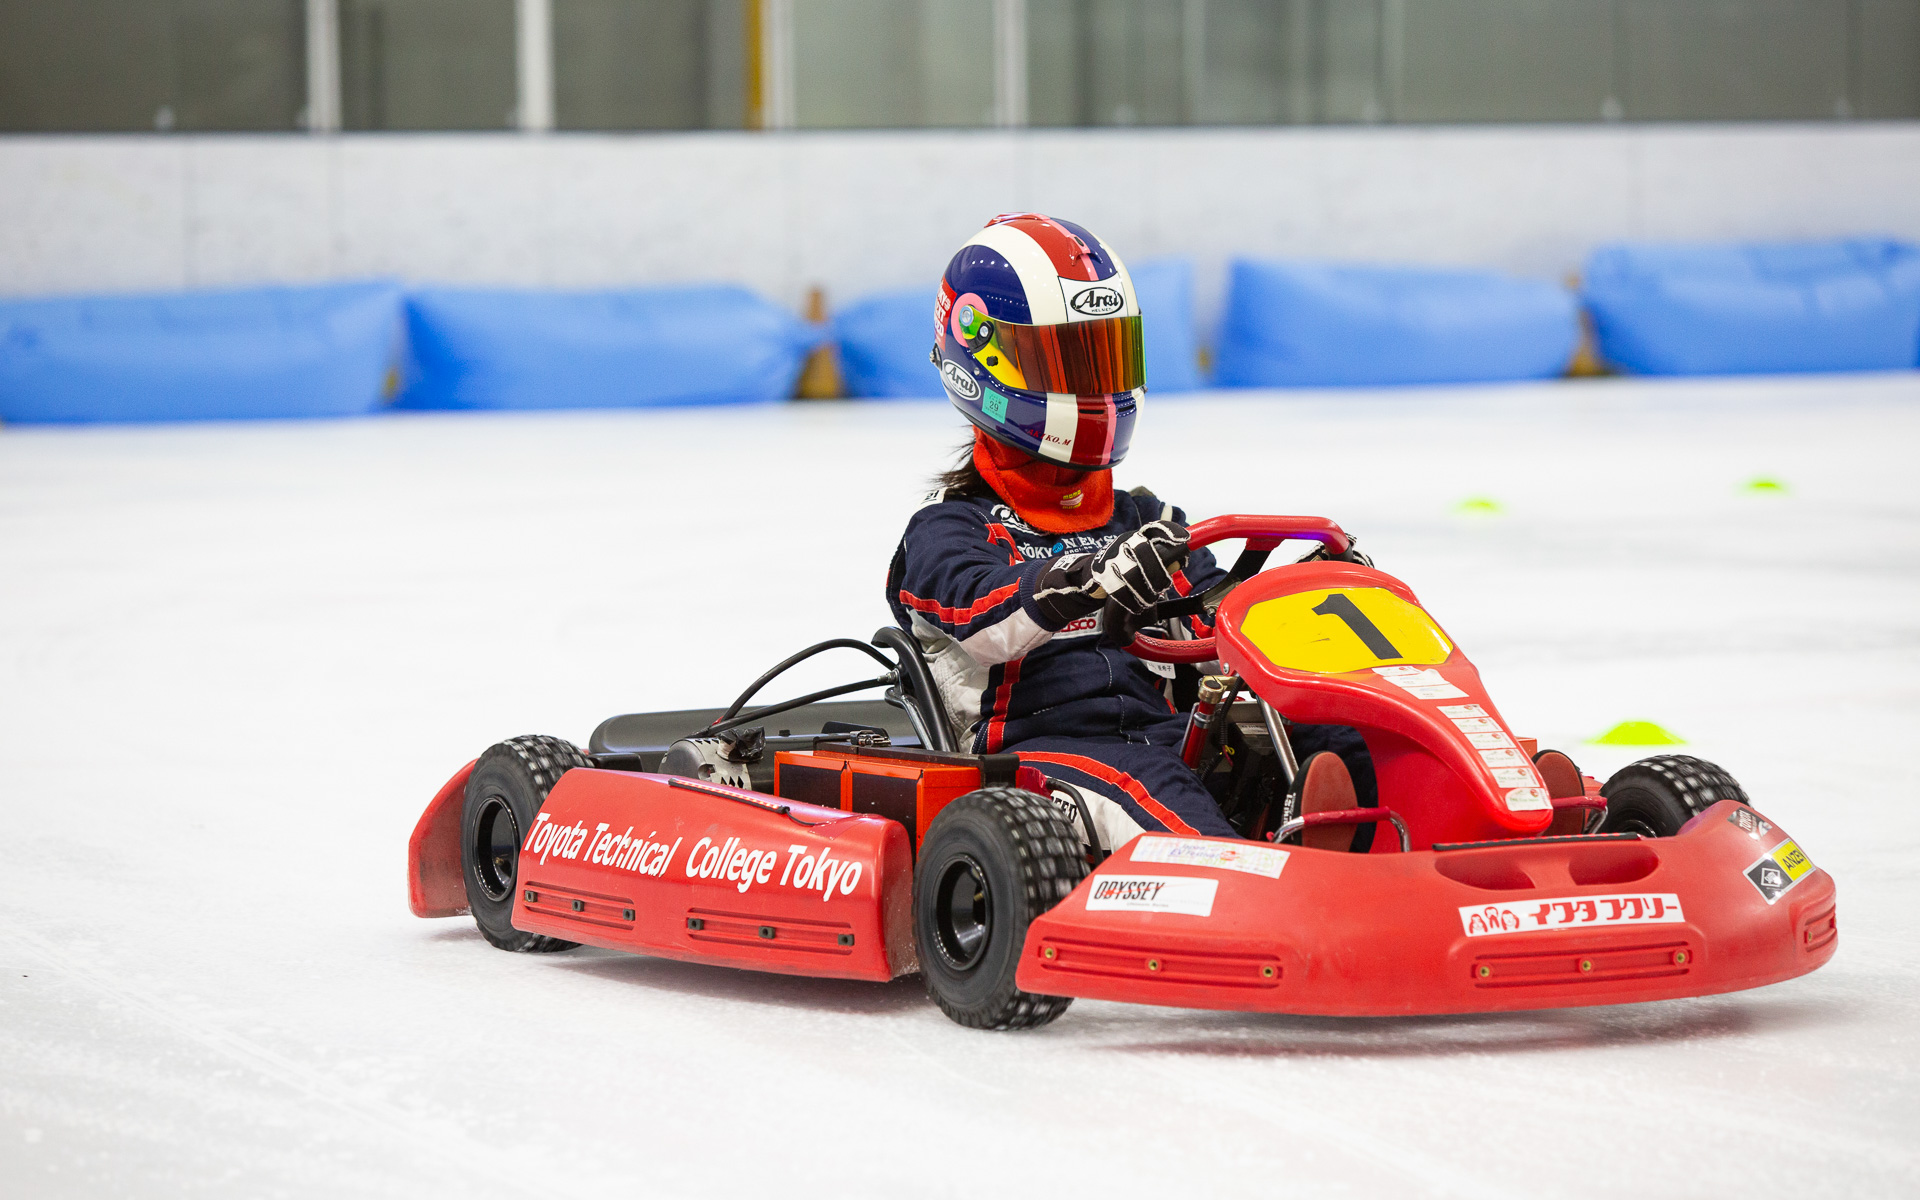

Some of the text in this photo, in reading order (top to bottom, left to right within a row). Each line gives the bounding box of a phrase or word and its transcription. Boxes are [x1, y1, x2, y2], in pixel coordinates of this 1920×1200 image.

[1074, 290, 1119, 309] Arai
[945, 366, 974, 394] Arai
[1311, 593, 1404, 660] 1
[525, 812, 863, 902] Toyota Technical College Tokyo
[1094, 880, 1165, 901] ODYSSEY
